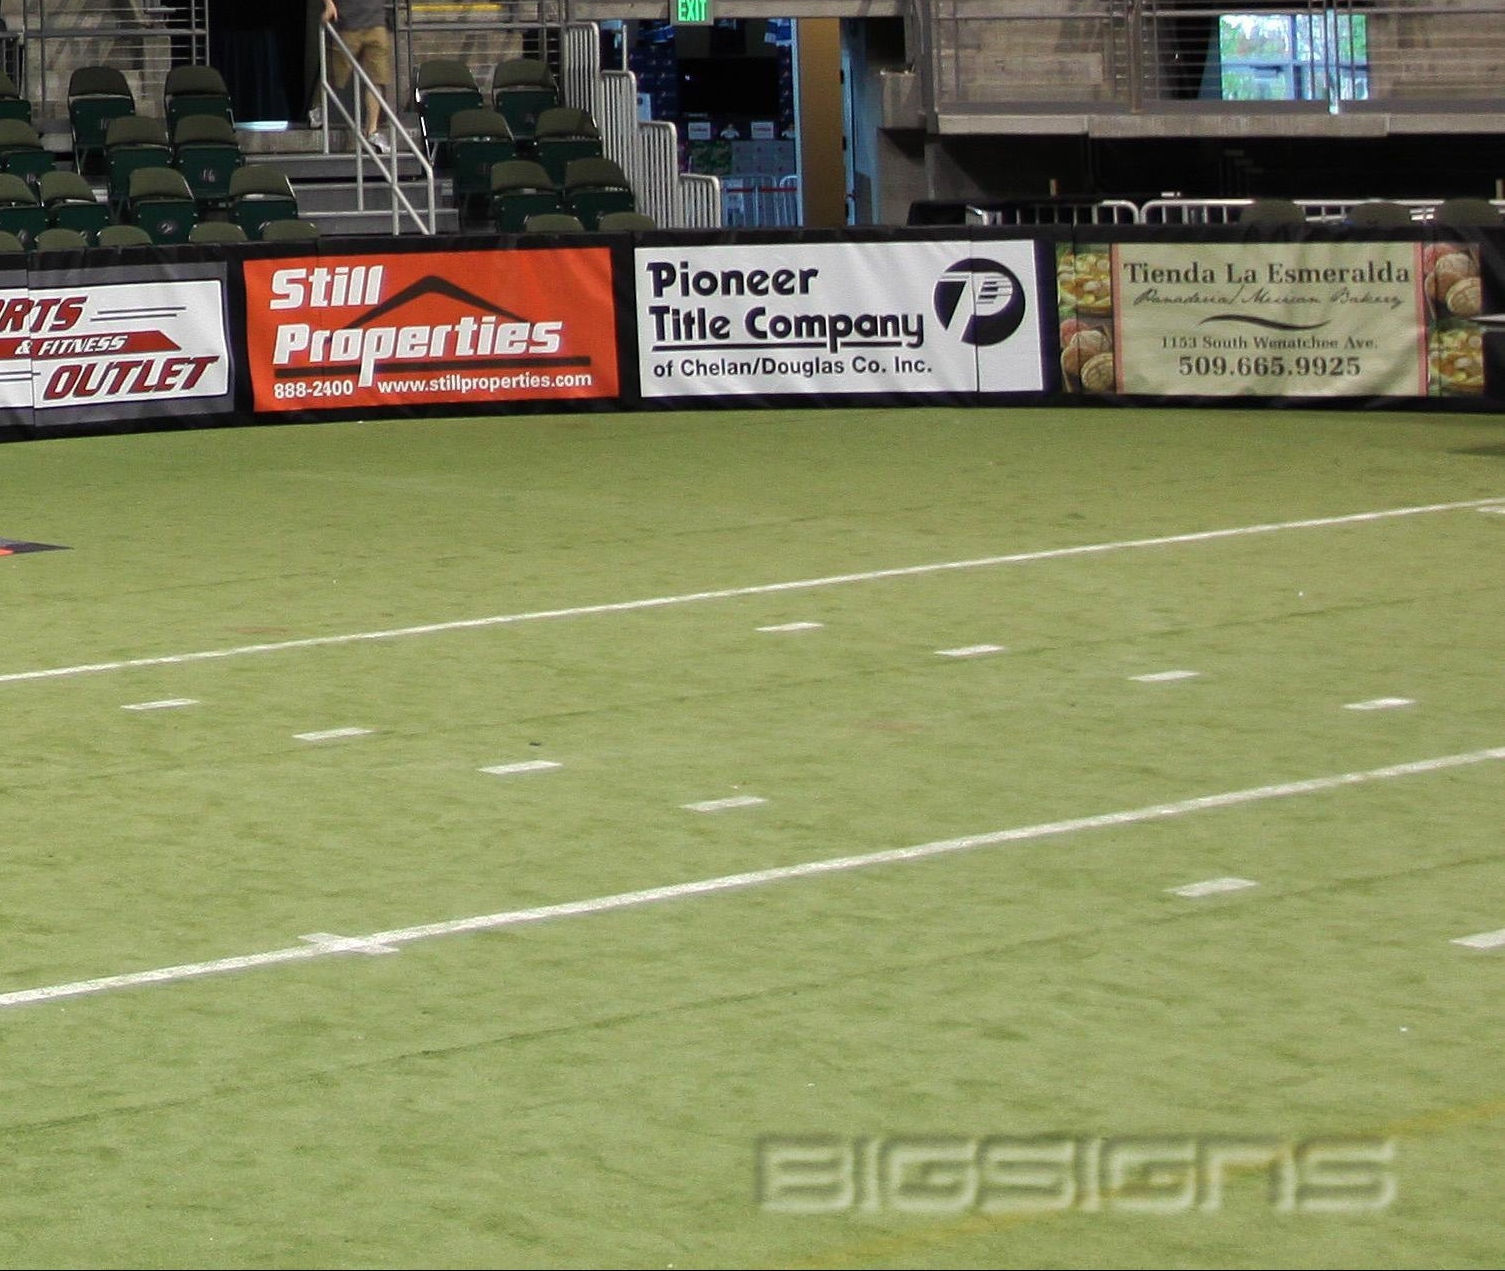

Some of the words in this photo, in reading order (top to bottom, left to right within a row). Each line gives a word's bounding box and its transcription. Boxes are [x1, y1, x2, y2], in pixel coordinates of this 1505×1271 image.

[269, 264, 384, 310] Still
[646, 260, 819, 299] Pioneer
[1123, 262, 1215, 285] Tienda
[1226, 262, 1257, 285] La
[1268, 260, 1410, 284] Esmeralda
[649, 305, 731, 342] Title
[744, 306, 924, 354] Company
[1202, 335, 1248, 349] South
[1253, 335, 1339, 350] Wenatchee
[1343, 335, 1378, 349] Ave.
[14, 339, 32, 355] &
[38, 334, 128, 356] FITNESS
[272, 315, 563, 388] Properties
[43, 356, 220, 401] OUTLET
[653, 358, 674, 378] of
[681, 355, 844, 378] Chelan/Douglas
[852, 356, 886, 375] Co.
[894, 356, 932, 375] Inc.
[1179, 356, 1361, 377] 509.665.9925
[273, 379, 354, 400] 888-2400
[377, 371, 592, 394] www.stillproperties.com
